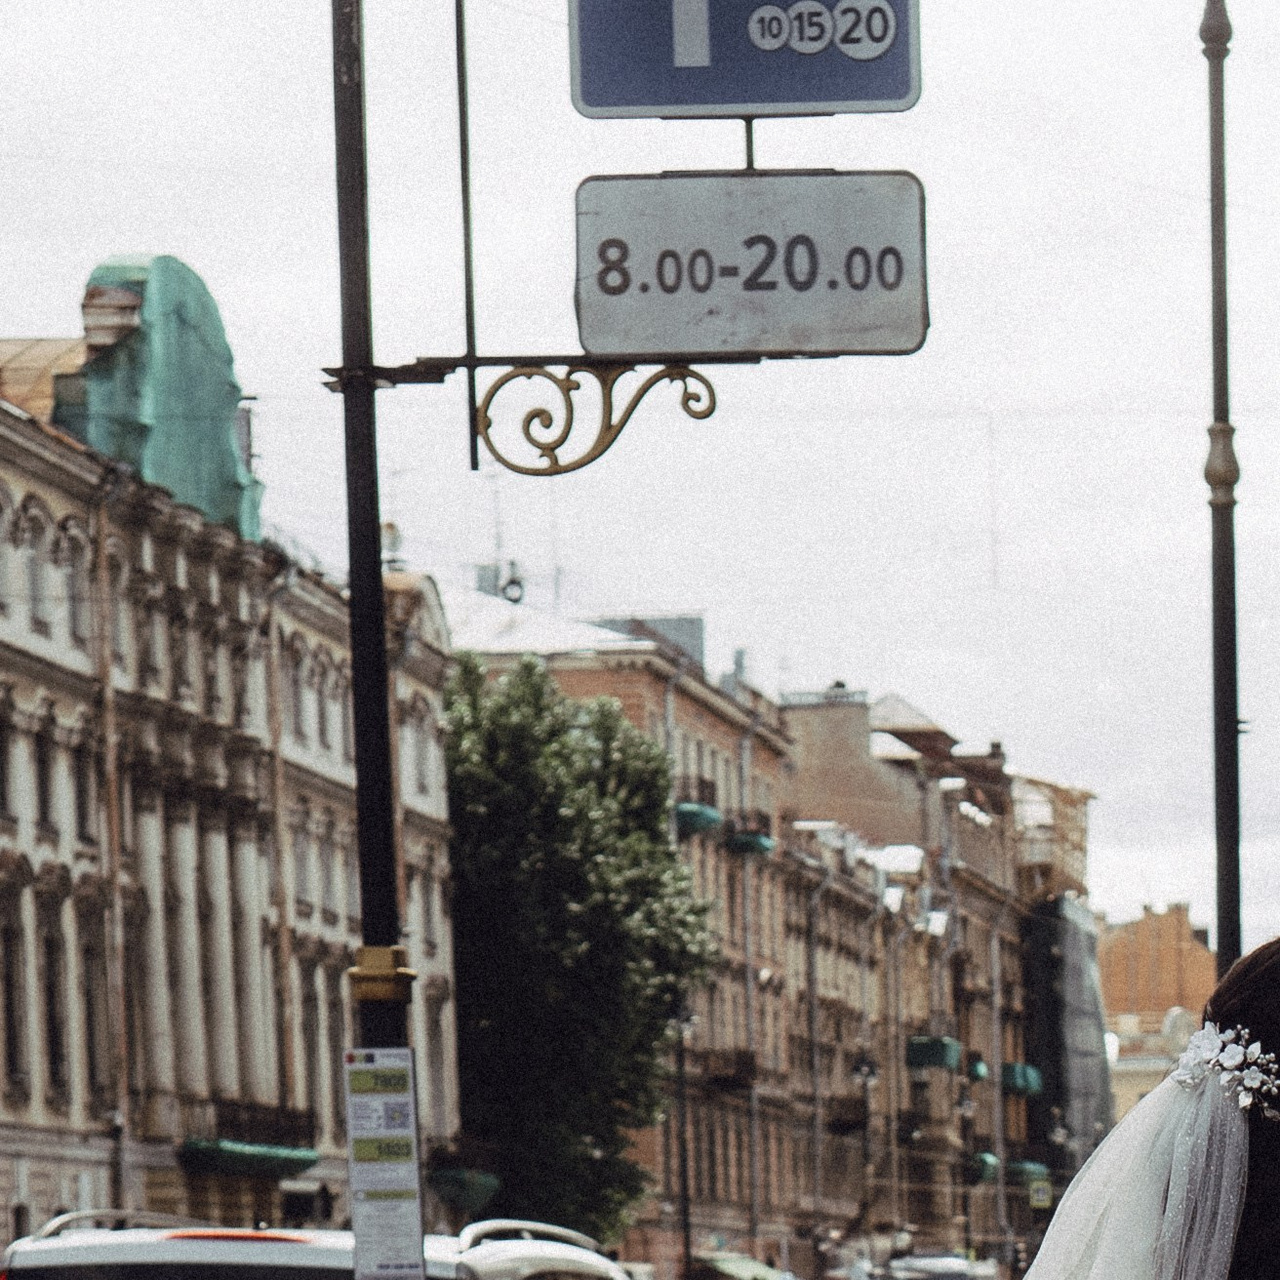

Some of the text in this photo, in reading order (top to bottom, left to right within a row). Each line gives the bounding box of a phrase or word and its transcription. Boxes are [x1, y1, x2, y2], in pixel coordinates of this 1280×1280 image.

[757, 6, 889, 44] 10 15 20
[597, 234, 904, 296] 8.00-20.00
